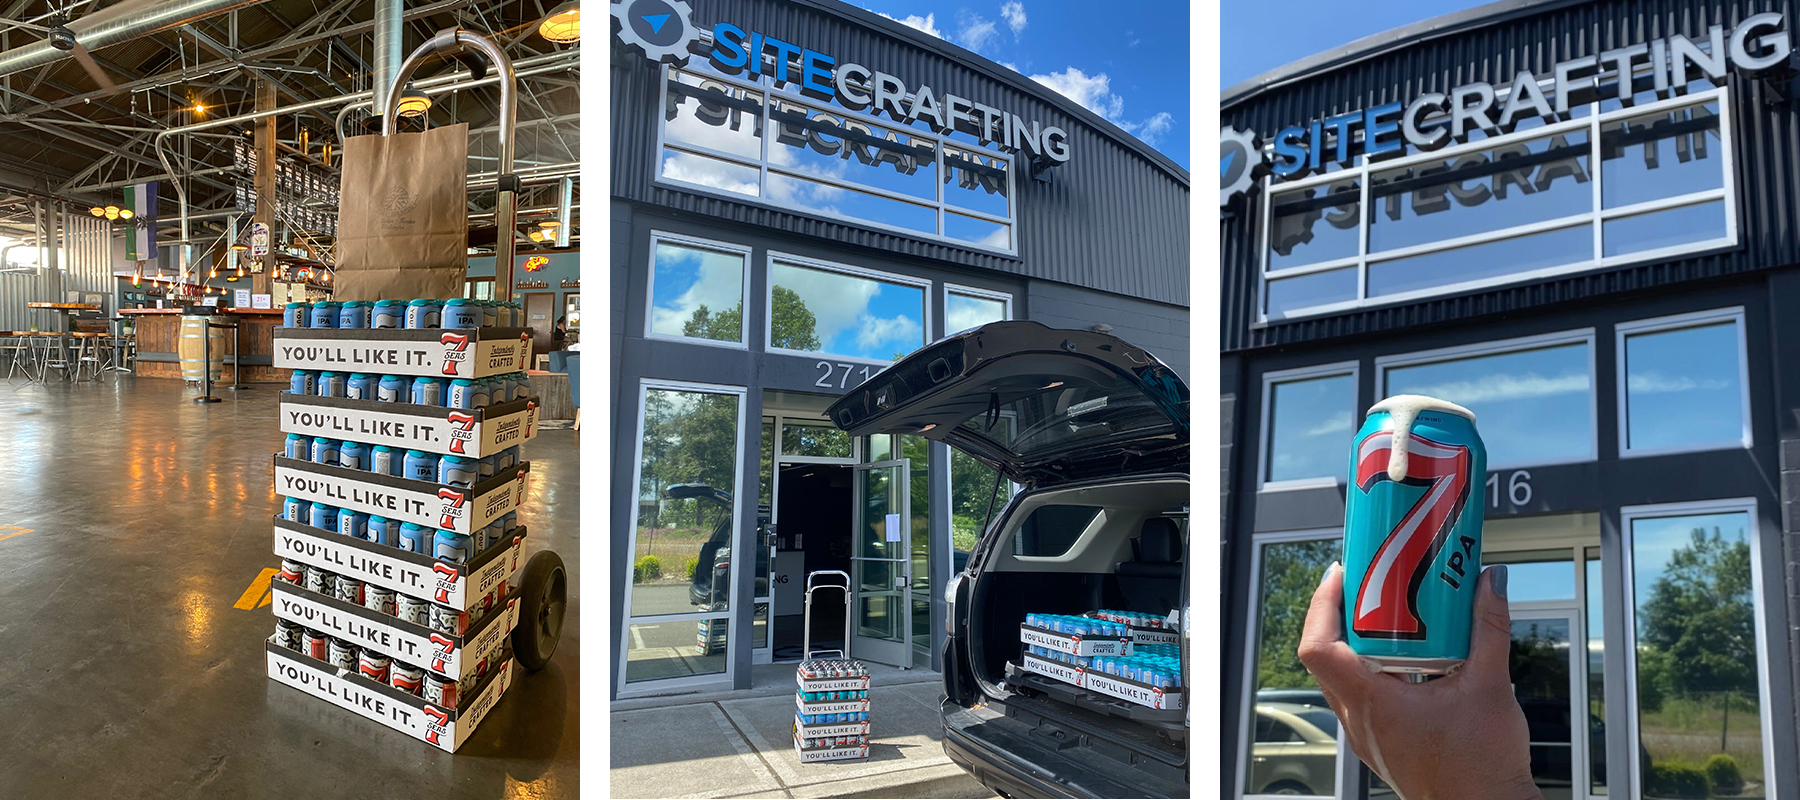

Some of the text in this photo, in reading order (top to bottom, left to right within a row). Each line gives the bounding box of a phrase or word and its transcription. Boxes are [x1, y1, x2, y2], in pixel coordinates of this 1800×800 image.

[709, 22, 1070, 165] SITECRAFTING
[1270, 12, 1791, 177] SITECRAFTING
[458, 317, 474, 325] IPA
[282, 347, 432, 367] YOU'LL LIKE IT.
[444, 351, 466, 360] SEAS
[489, 357, 514, 369] CRAFTED
[815, 361, 885, 389] 271
[290, 411, 439, 442] YOU'LL LIKE IT.
[451, 429, 473, 439] SEAS
[495, 429, 519, 444] CRAFTED
[284, 475, 430, 517] YOU'LL LIKE IT.
[1486, 470, 1532, 508] 16
[442, 505, 463, 516] SEAS
[485, 498, 510, 519] CRAFTED
[1352, 428, 1472, 641] 7
[283, 535, 425, 589] YOU'LL LIKE IT.
[1440, 535, 1476, 591] IPA
[436, 579, 457, 592] SEAS
[480, 568, 505, 592] CRAFTED
[281, 598, 422, 658] YOU'LL LIKE IT.
[1136, 633, 1160, 642] YOU'LL
[475, 631, 500, 659] CRAFTED
[1024, 632, 1071, 650] YOU'LL LIKE IT.
[433, 649, 453, 663] SEAS
[1027, 660, 1074, 680] YOU'LL LIKE IT.
[276, 661, 416, 729] YOU'LL LIKE IT.
[1091, 678, 1151, 702] YOU'LL LIKE IT.
[807, 704, 832, 712] YOU'LL
[426, 721, 447, 735] SEAS
[807, 728, 832, 736] YOU'LL
